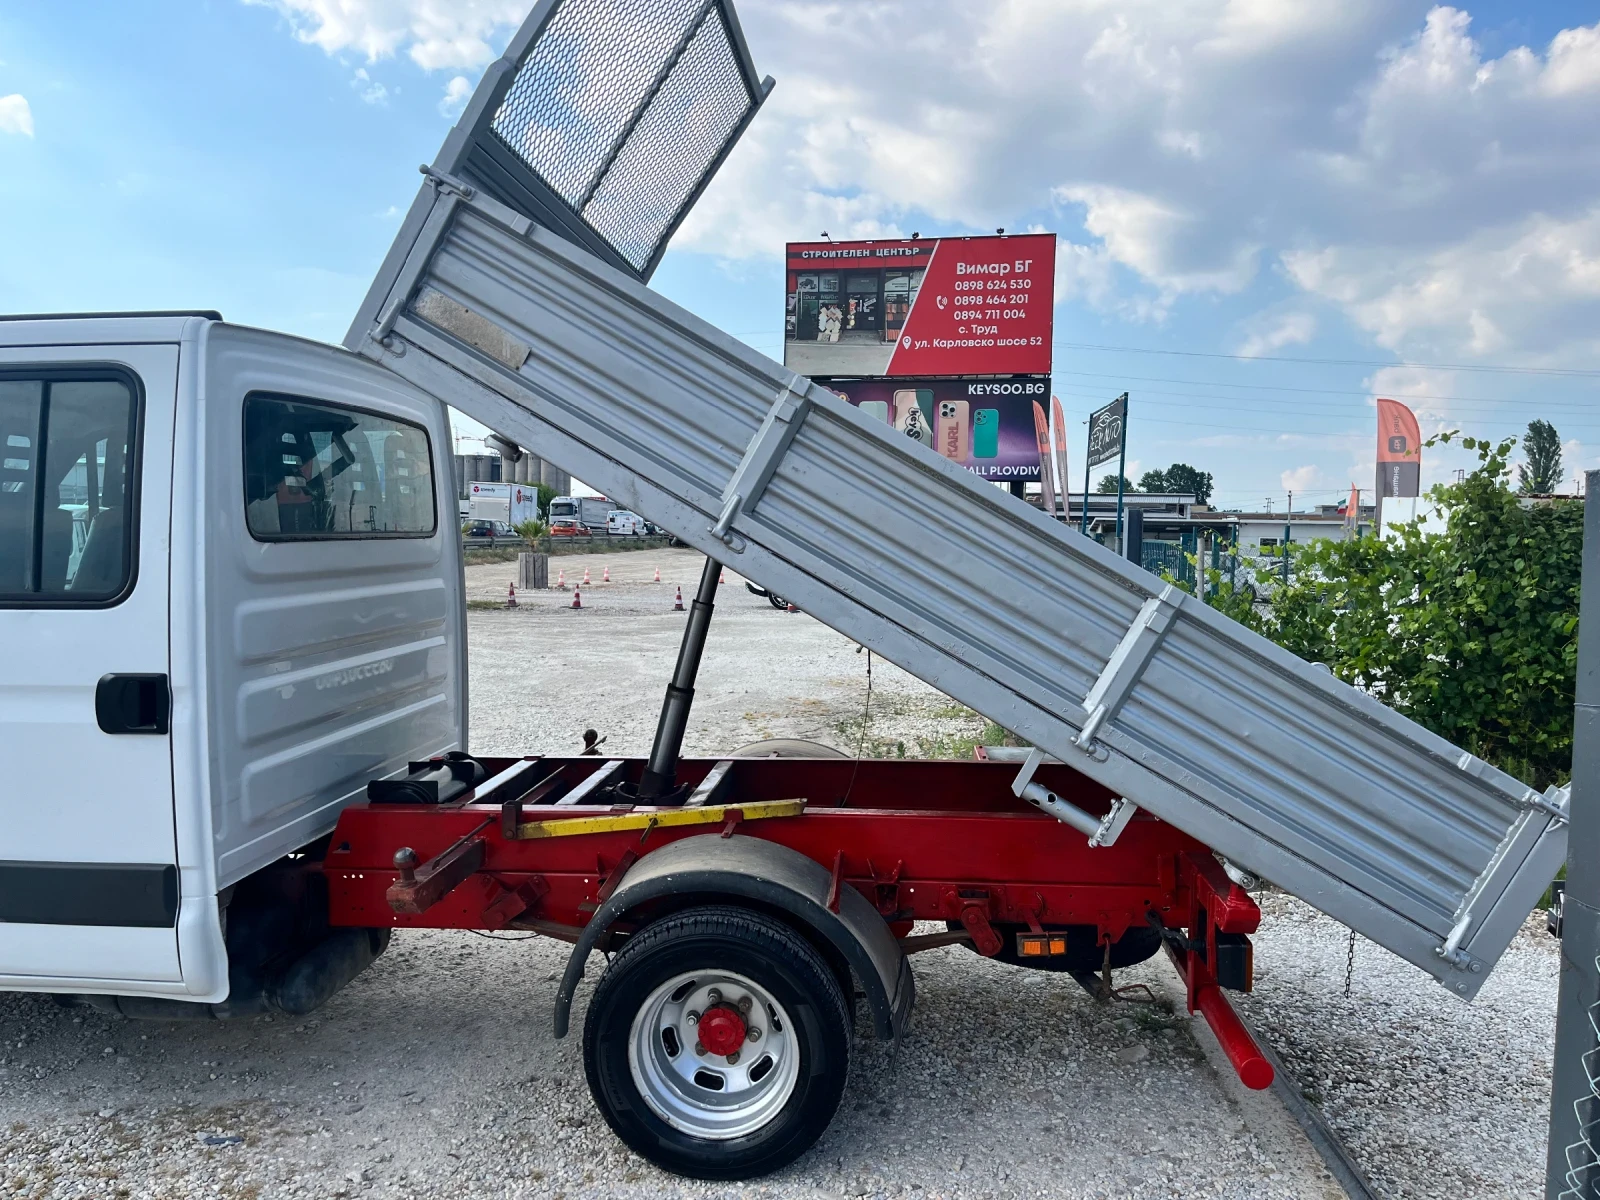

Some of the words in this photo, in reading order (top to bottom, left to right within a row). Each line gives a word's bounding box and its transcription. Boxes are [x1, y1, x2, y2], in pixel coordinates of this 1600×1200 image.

[802, 249, 870, 259] СТРОИТЕЛЕН
[876, 247, 920, 258] ЦЕНТЪР
[956, 262, 1011, 276] Вимар
[1014, 260, 1033, 273] БГ
[954, 281, 984, 291] 0898
[986, 280, 1007, 290] 624
[1009, 279, 1032, 289] 530
[954, 296, 983, 306] 0898
[986, 295, 1007, 305] 464
[1009, 294, 1029, 304] 201
[953, 310, 982, 320] 0894
[985, 309, 1001, 319] 711
[1003, 309, 1026, 319] 004
[958, 326, 968, 334] с.
[971, 324, 998, 335] Труд
[914, 340, 930, 350] ул.
[933, 337, 994, 349] Карловско
[997, 338, 1027, 347] шосе
[1030, 337, 1042, 346] 52
[968, 383, 1045, 395] KEYSOO.BG
[947, 421, 959, 458] KARL
[964, 466, 987, 476] ALL
[989, 465, 1040, 476] PLOVDIV
